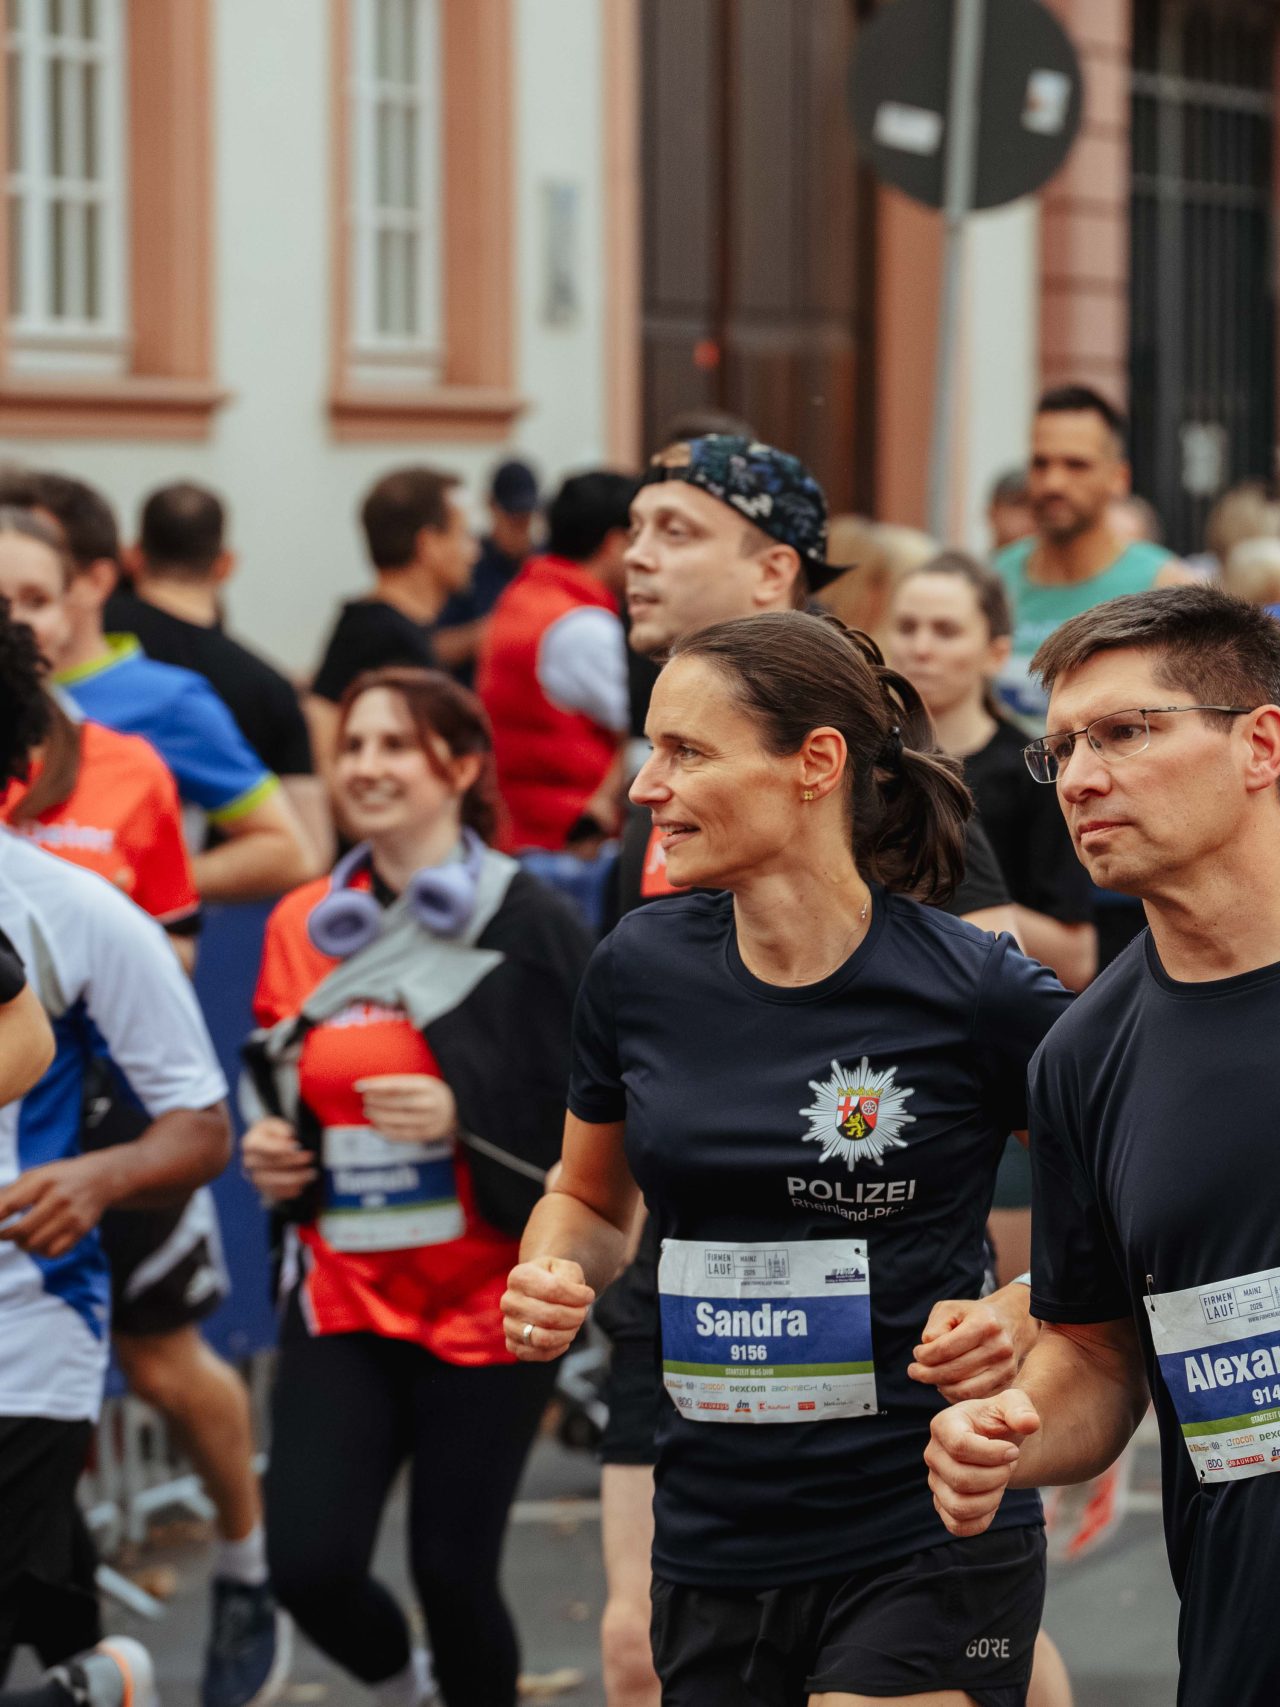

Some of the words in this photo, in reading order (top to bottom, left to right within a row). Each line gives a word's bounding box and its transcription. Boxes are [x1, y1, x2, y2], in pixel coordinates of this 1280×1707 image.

[787, 1176, 917, 1203] POLIZEI
[791, 1197, 906, 1222] Rheinland-Pf
[707, 1253, 731, 1262] FIRMEN
[708, 1263, 731, 1275] LAUF
[1203, 1292, 1233, 1306] FIRMEN
[1243, 1286, 1262, 1297] MAINZ
[1206, 1302, 1235, 1320] LAUF
[696, 1302, 808, 1337] Sandra
[730, 1344, 768, 1361] 9156
[1250, 1410, 1278, 1424] STARTZEIT
[1206, 1457, 1223, 1469] BDO
[965, 1638, 1010, 1658] GORE
